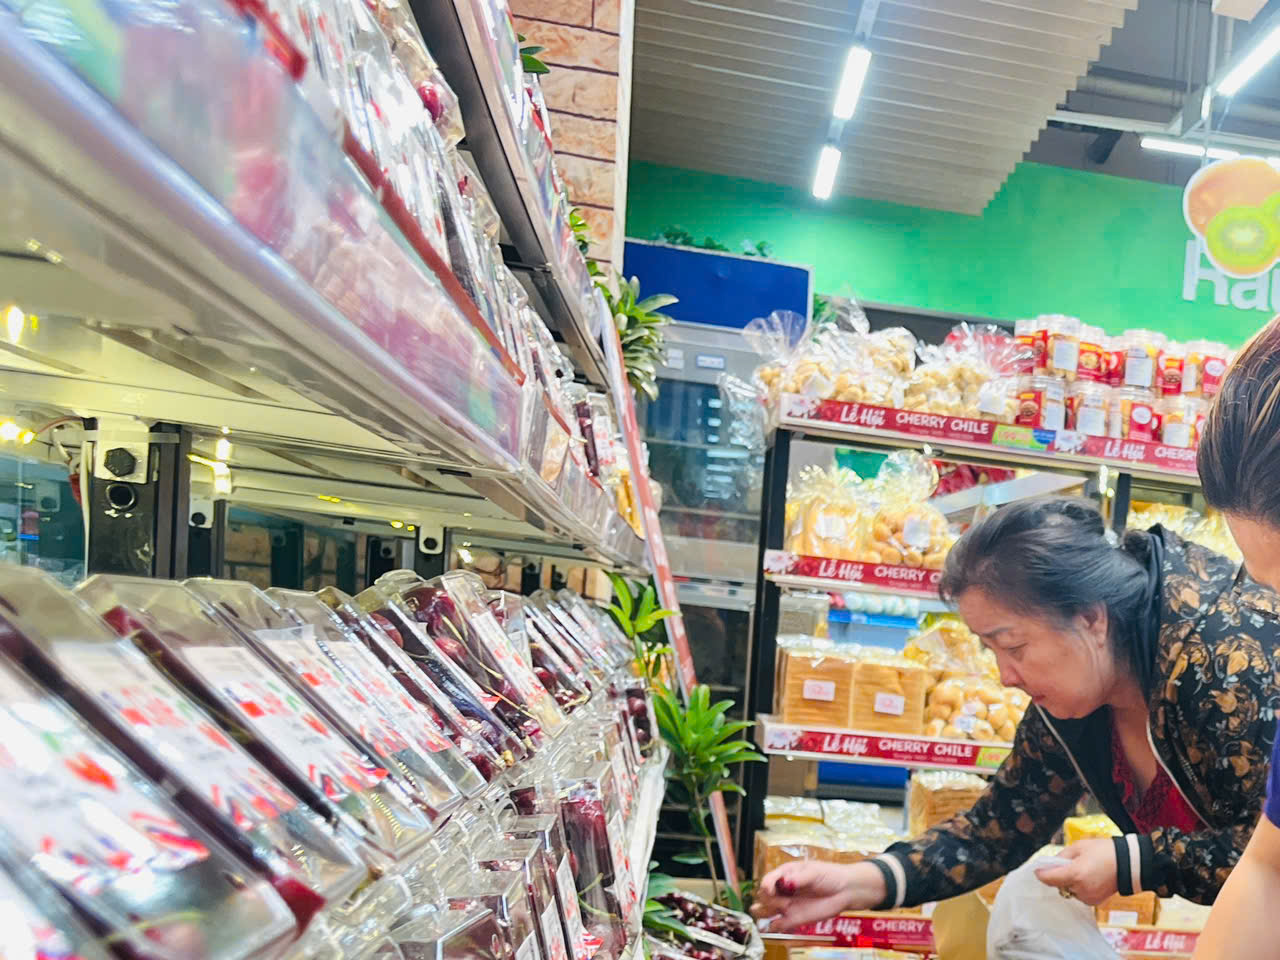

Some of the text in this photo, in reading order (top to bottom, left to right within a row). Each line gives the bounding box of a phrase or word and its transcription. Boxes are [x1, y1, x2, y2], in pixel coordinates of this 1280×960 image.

[895, 412, 948, 429] CHERRY
[950, 418, 989, 434] CHILE
[1154, 446, 1197, 461] CHERR
[874, 566, 927, 582] CHERRY
[878, 739, 931, 754] CHERRY
[934, 743, 973, 758] CHILE
[872, 919, 926, 933] CHERRY
